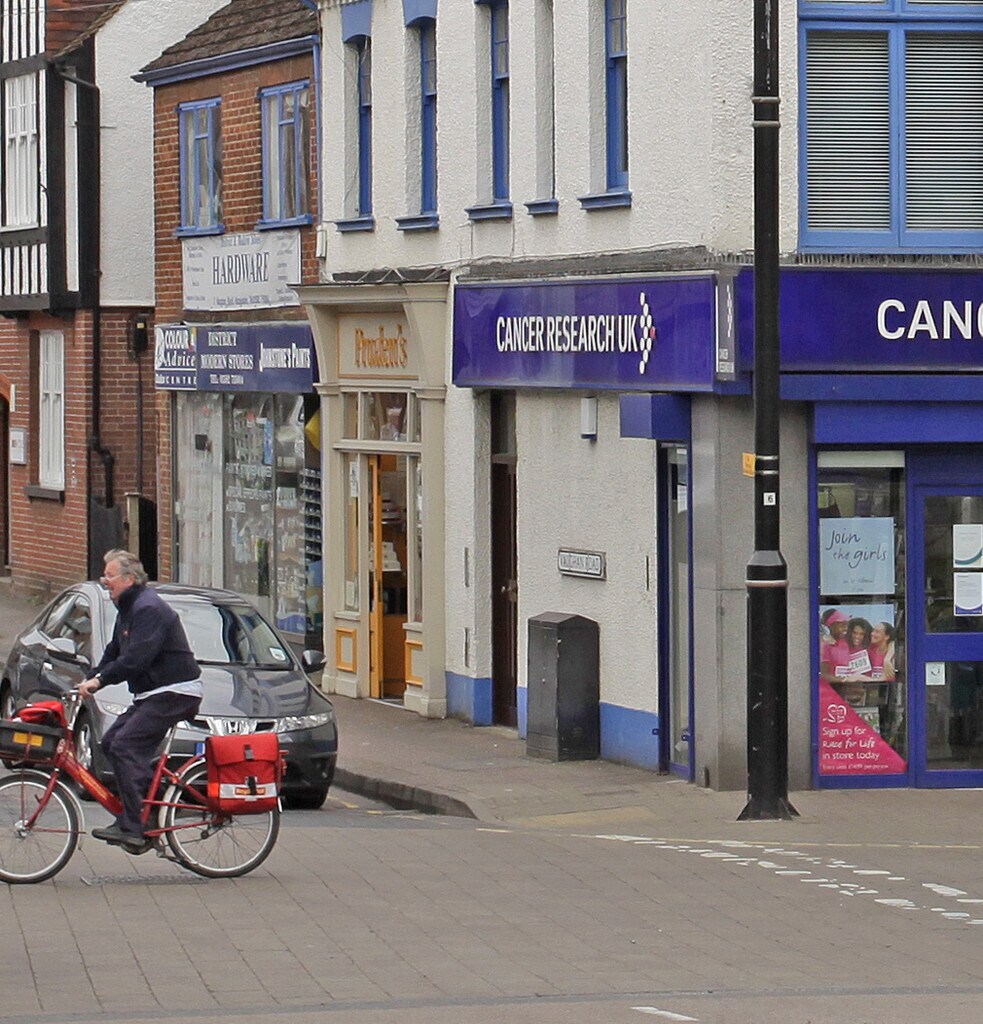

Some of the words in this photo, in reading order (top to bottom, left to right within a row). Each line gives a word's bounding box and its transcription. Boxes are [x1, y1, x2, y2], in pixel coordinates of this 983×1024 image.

[212, 252, 270, 285] HARDWARE
[165, 329, 189, 350] COLOUR
[208, 331, 237, 346] DISTRICT
[496, 316, 544, 353] CANCER
[547, 315, 614, 353] RESEARCH
[618, 314, 639, 353] UK
[164, 350, 197, 367] Advice
[228, 354, 254, 369] STORES
[767, 494, 774, 503] 6
[825, 527, 861, 551] Join
[833, 546, 850, 561] the
[848, 543, 887, 569] girls
[822, 726, 839, 737] Sign
[841, 729, 852, 737] up
[853, 725, 867, 735] for
[822, 740, 843, 748] Race
[844, 737, 858, 749] for
[859, 736, 876, 748] Life
[822, 752, 831, 760] in
[856, 751, 880, 761] today
